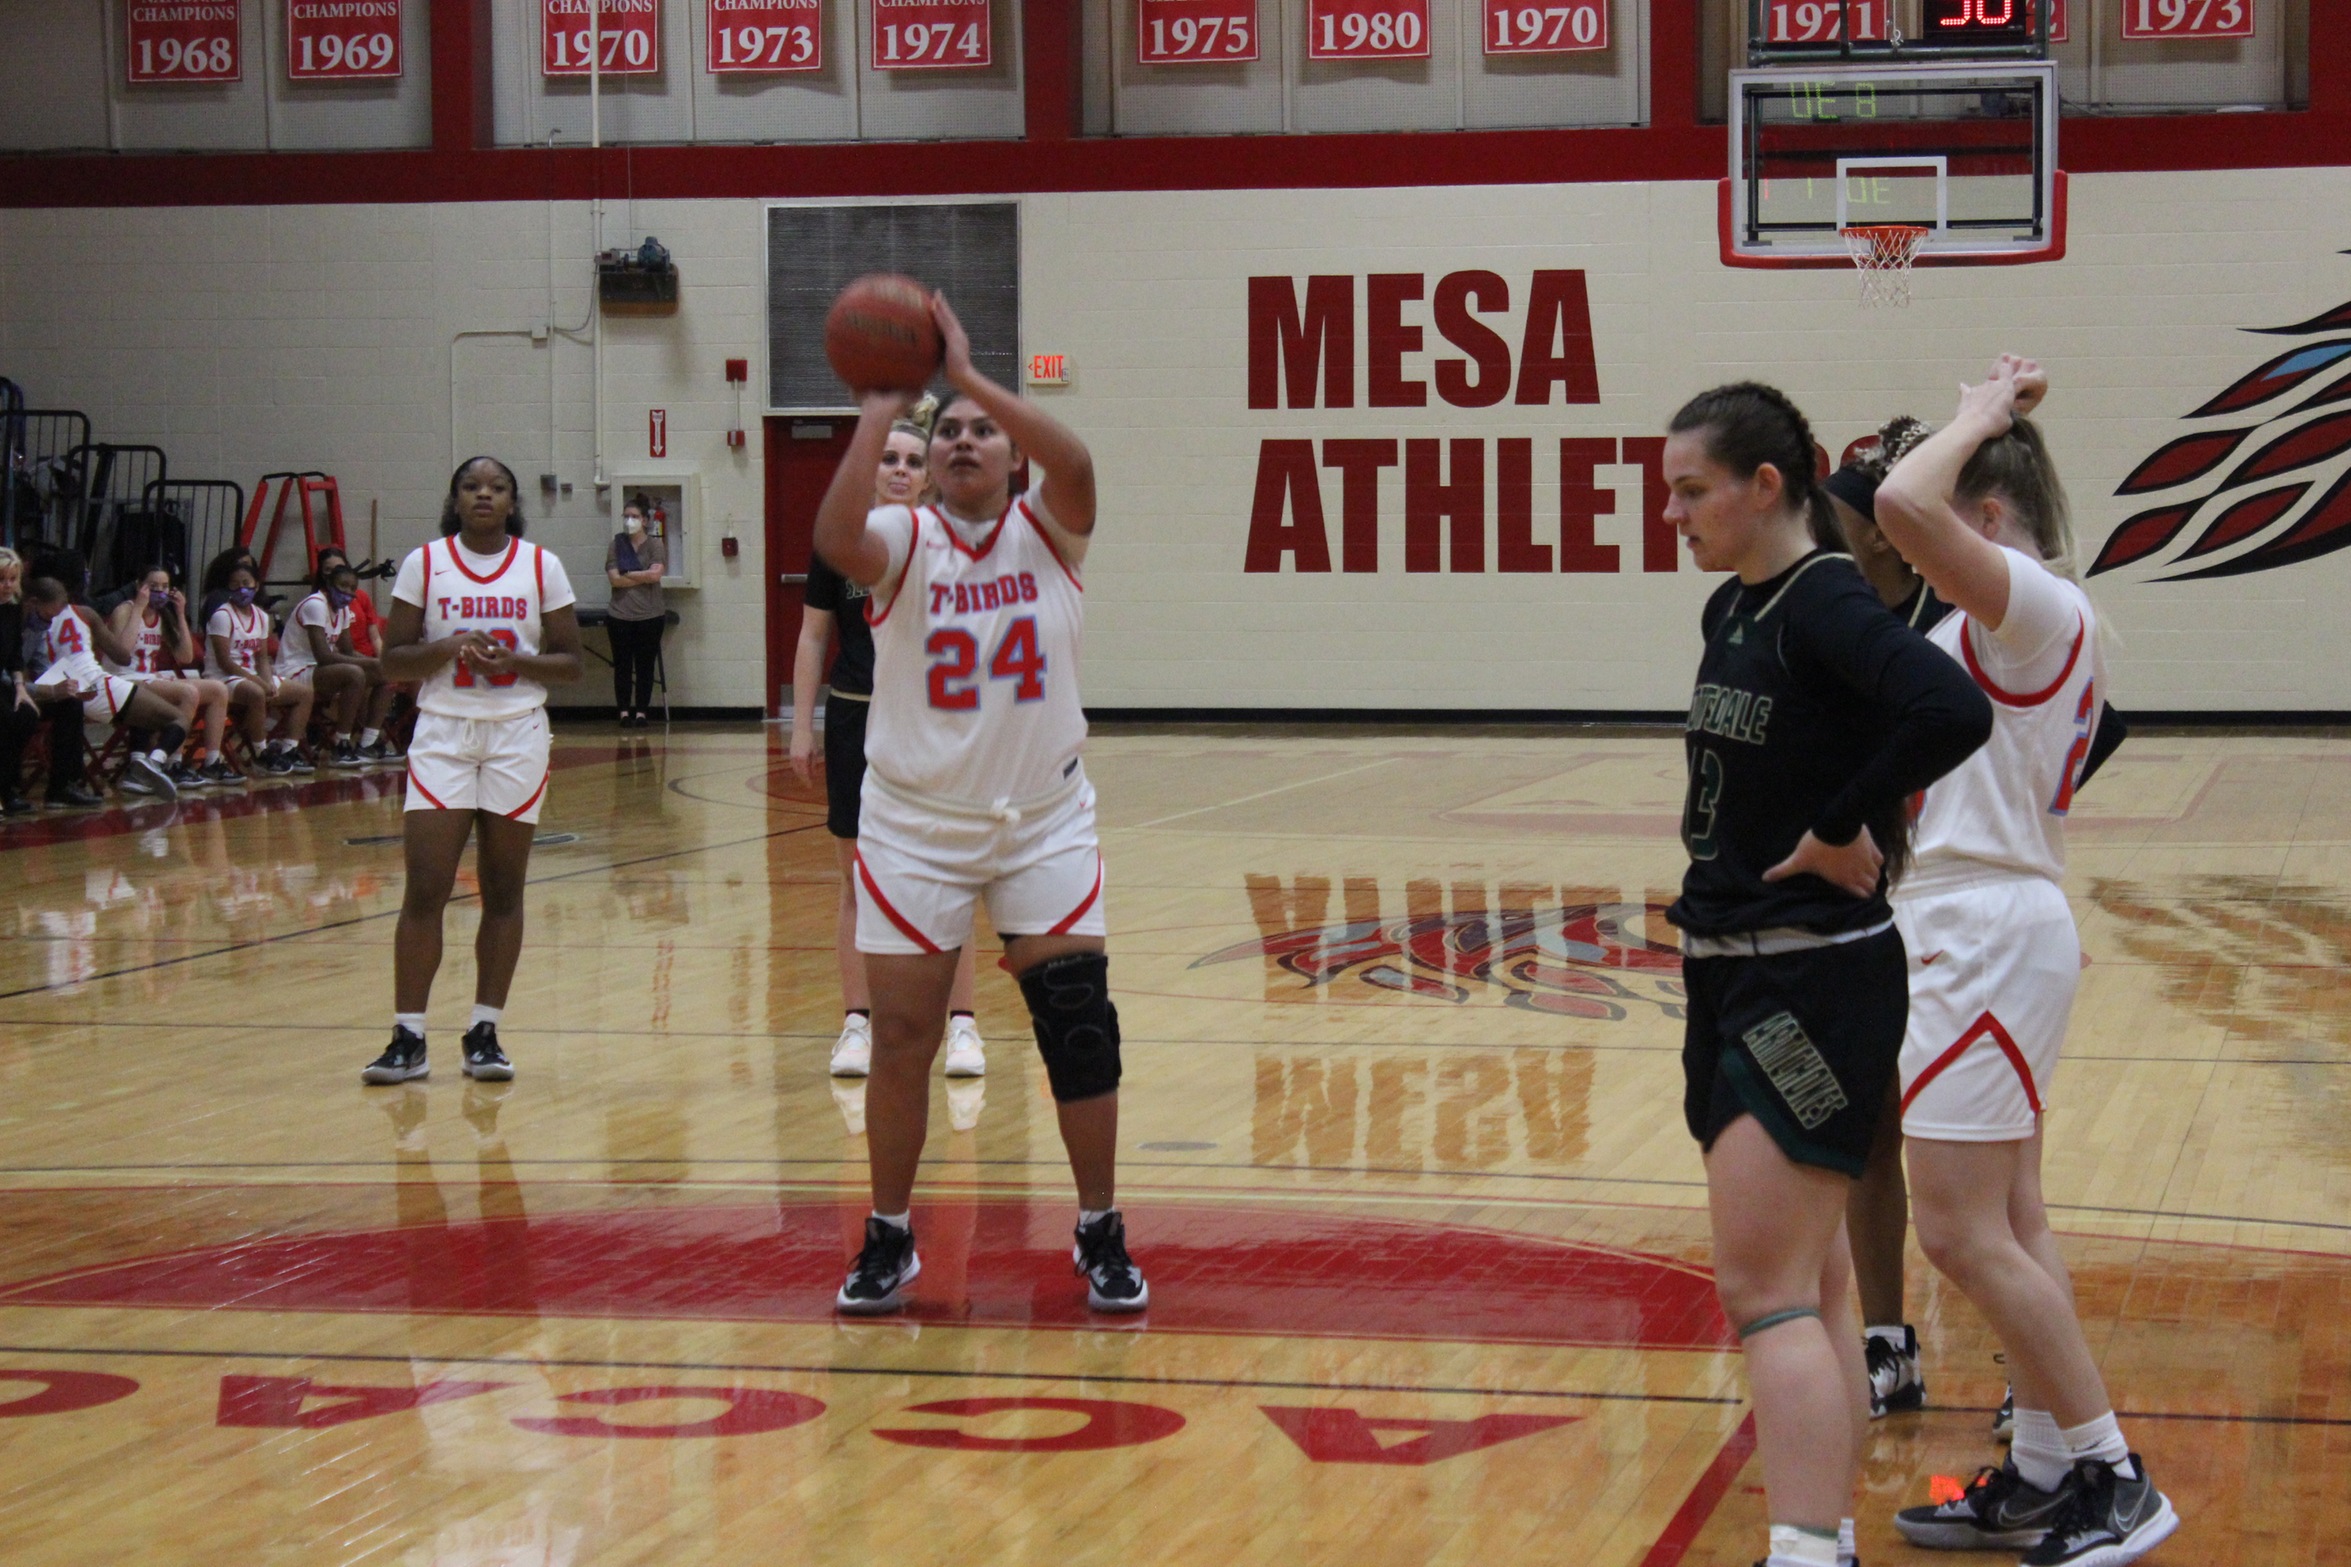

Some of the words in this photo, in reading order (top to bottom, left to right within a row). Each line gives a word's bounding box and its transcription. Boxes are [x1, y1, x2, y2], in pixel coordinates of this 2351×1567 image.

[132, 6, 235, 22] CHAMPIONS
[293, 2, 397, 19] CHAMPIONS
[1493, 7, 1598, 46] 1970
[1772, 1, 1876, 42] 1971
[2132, 0, 2244, 31] 1973
[552, 29, 650, 67] 1970
[718, 26, 814, 64] 1973
[883, 22, 981, 61] 1974
[1150, 17, 1249, 55] 1975
[1319, 12, 1421, 51] 1980
[137, 37, 232, 74] 1968
[298, 33, 394, 71] 1969
[1248, 269, 1601, 409] MESA
[1033, 355, 1064, 379] EXIT
[1243, 436, 1720, 573] ATHLET
[437, 596, 528, 621] T-BIRDS
[930, 571, 1039, 616] T-BIRDS
[924, 613, 1048, 713] 24
[1686, 683, 1774, 746] TSDALE
